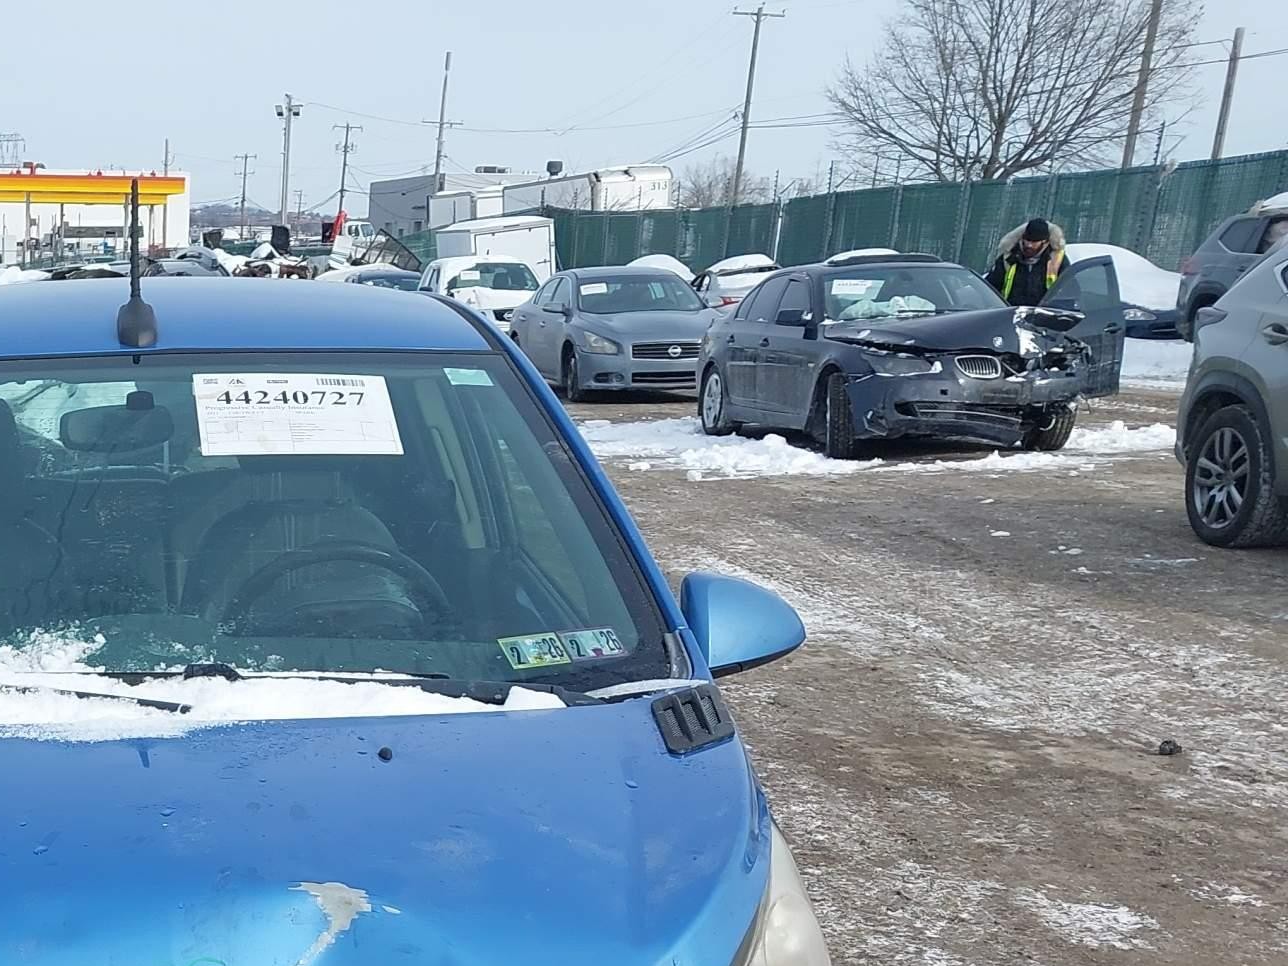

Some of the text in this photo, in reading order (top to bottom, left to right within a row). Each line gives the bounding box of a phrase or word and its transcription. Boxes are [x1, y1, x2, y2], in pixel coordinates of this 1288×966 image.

[650, 181, 668, 191] 313
[216, 390, 365, 405] 44240727
[510, 637, 565, 665] 2 26
[570, 630, 622, 657] 2 26
